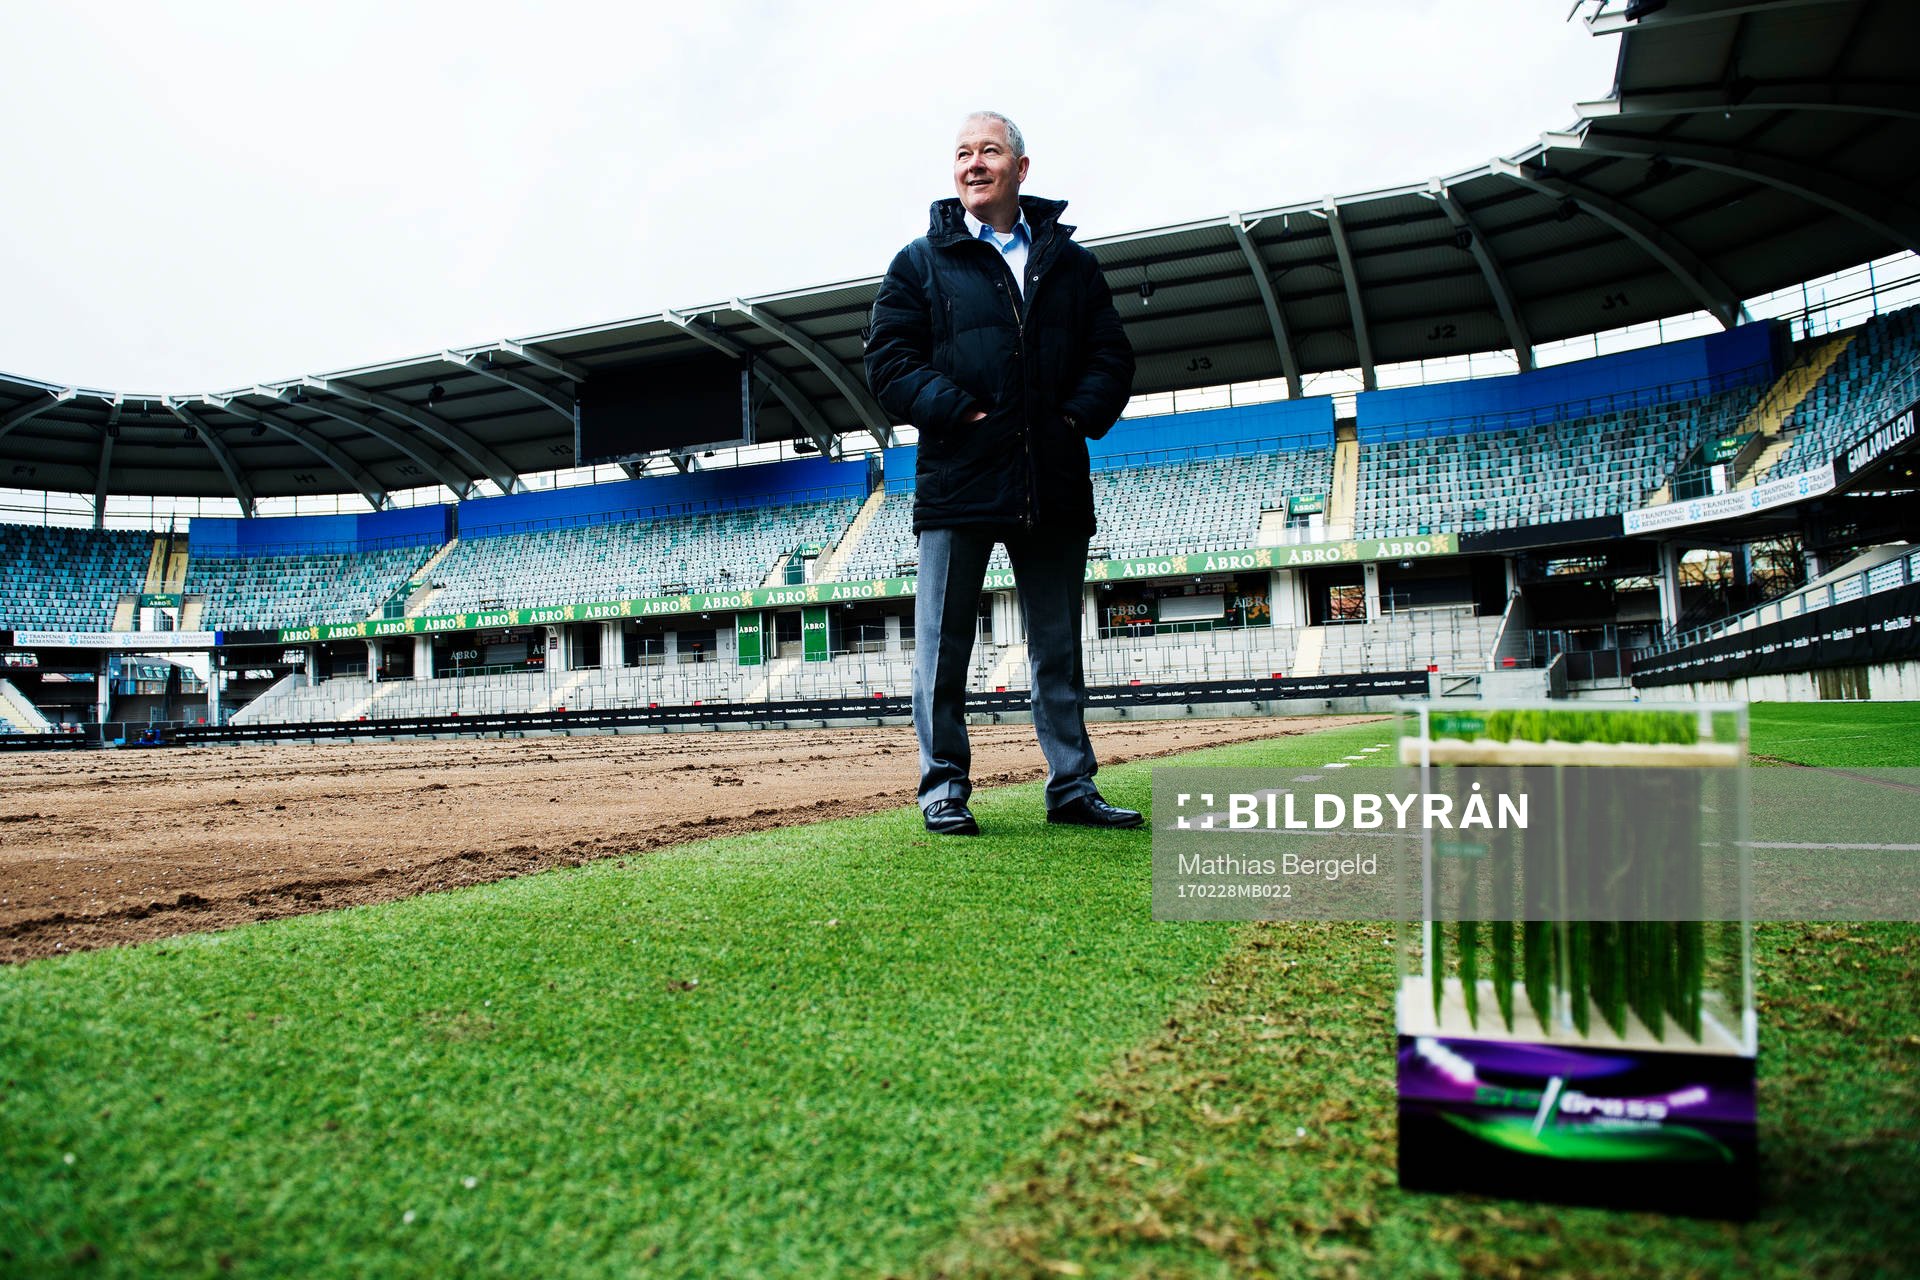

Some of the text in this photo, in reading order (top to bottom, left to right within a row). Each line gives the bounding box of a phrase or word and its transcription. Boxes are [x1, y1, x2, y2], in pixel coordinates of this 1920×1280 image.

[1428, 324, 1457, 341] J2
[1186, 357, 1212, 371] J3
[983, 574, 1016, 588] BRO
